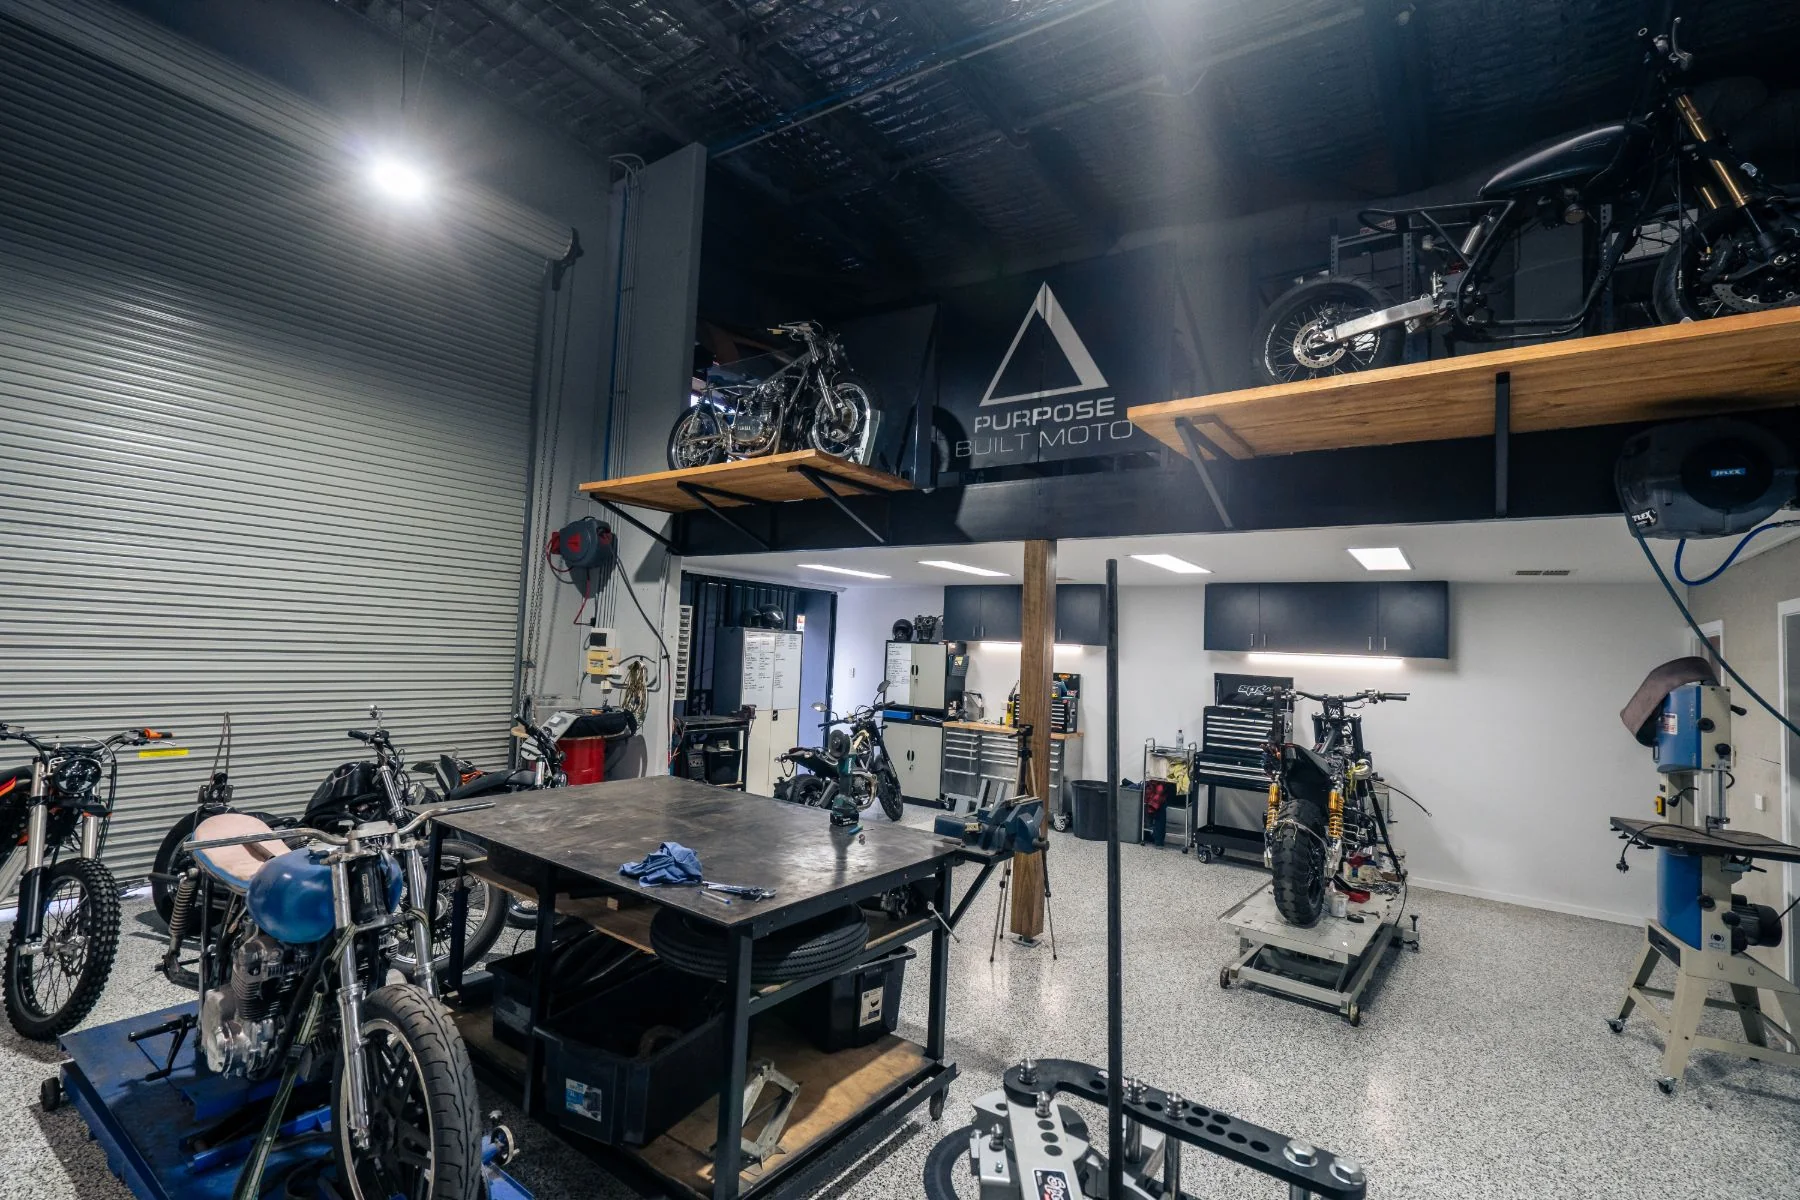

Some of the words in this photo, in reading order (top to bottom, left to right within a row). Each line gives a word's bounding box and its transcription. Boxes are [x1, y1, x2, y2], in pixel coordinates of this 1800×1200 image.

[974, 397, 1115, 433] PURPOSE
[955, 432, 1031, 457] BUILT
[1039, 420, 1132, 448] MOTO
